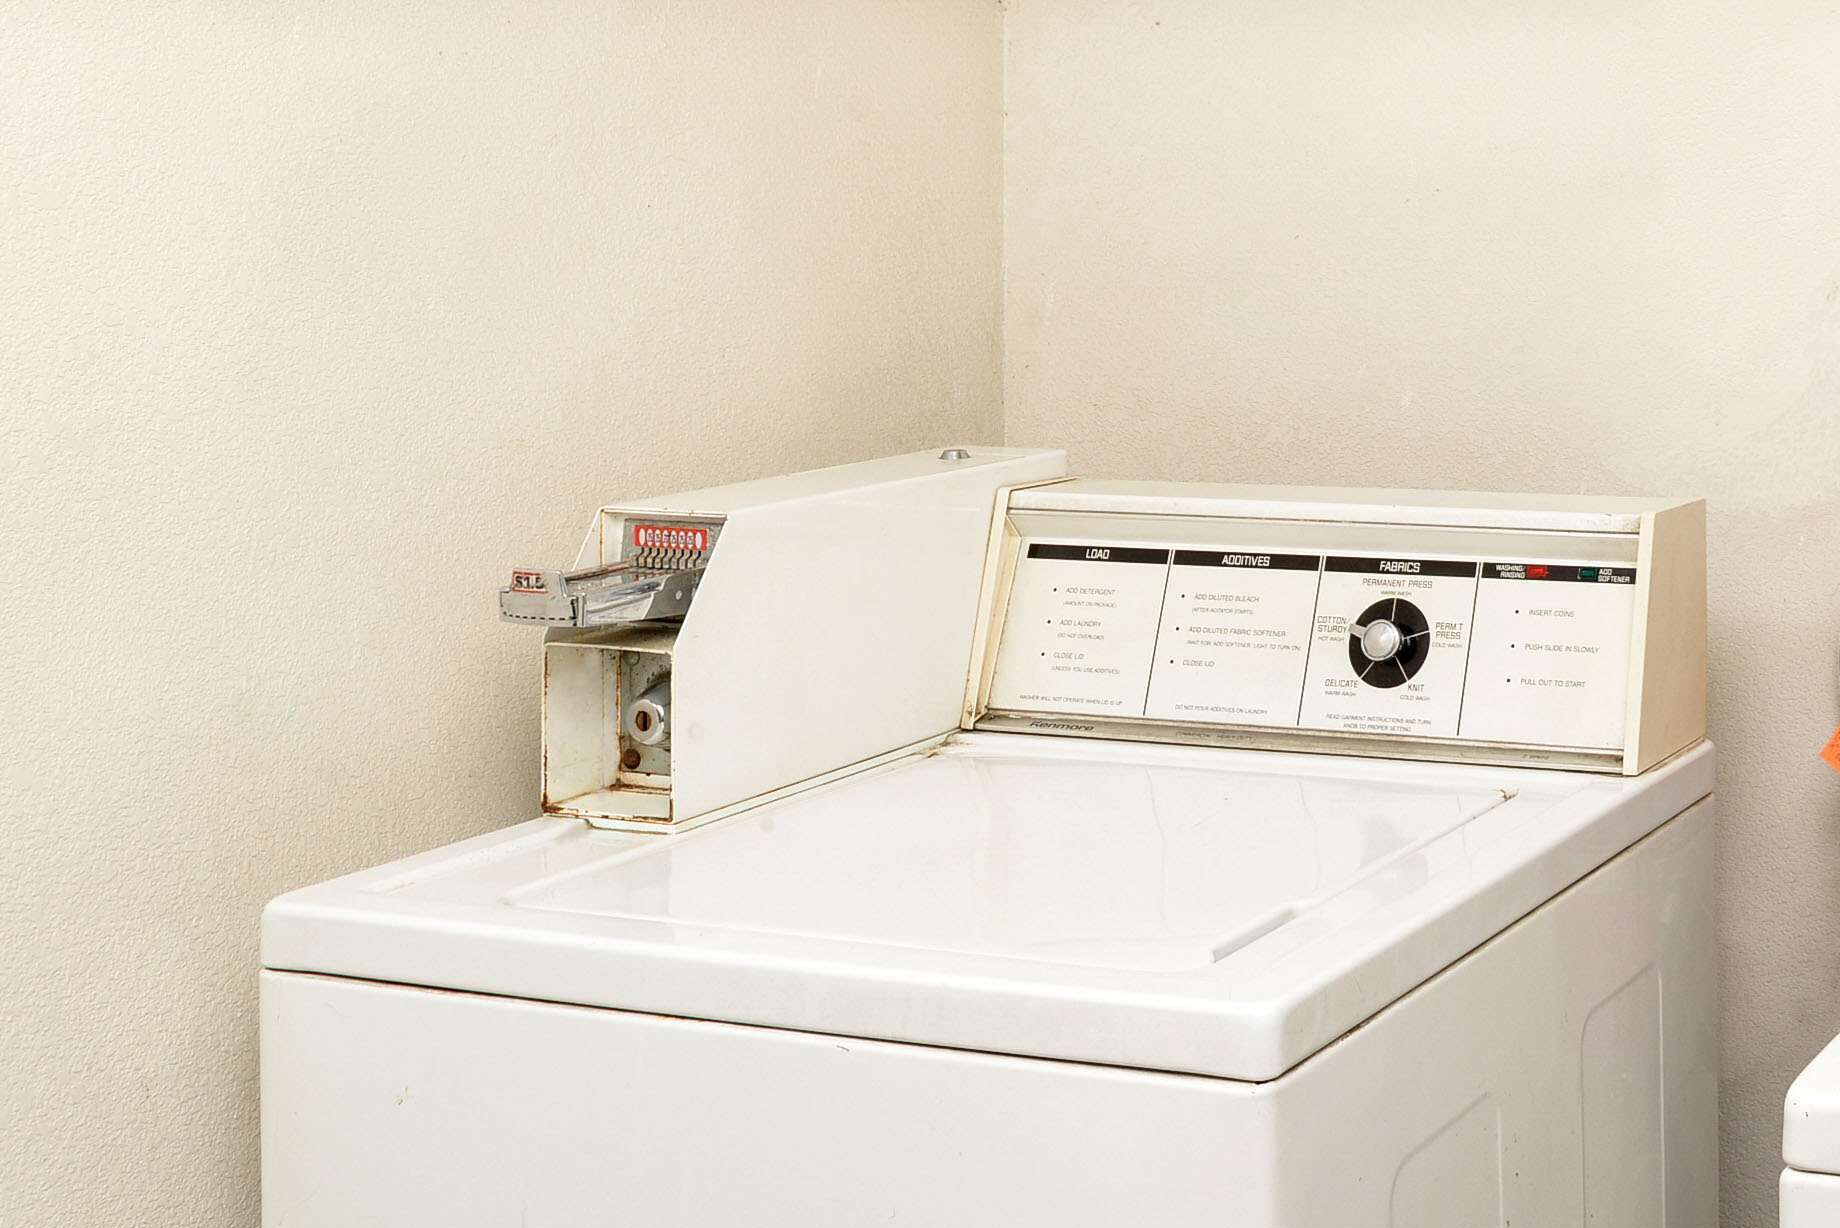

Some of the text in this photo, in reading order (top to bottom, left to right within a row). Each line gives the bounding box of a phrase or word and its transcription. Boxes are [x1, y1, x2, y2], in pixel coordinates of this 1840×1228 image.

[1085, 548, 1111, 560] LOAD
[1221, 554, 1271, 567] ADDITIVES
[1379, 560, 1421, 573] FABRICS
[1496, 564, 1527, 573] WASHING/
[1598, 574, 1631, 584] SOFTENER
[1029, 720, 1096, 733] Kenmore
